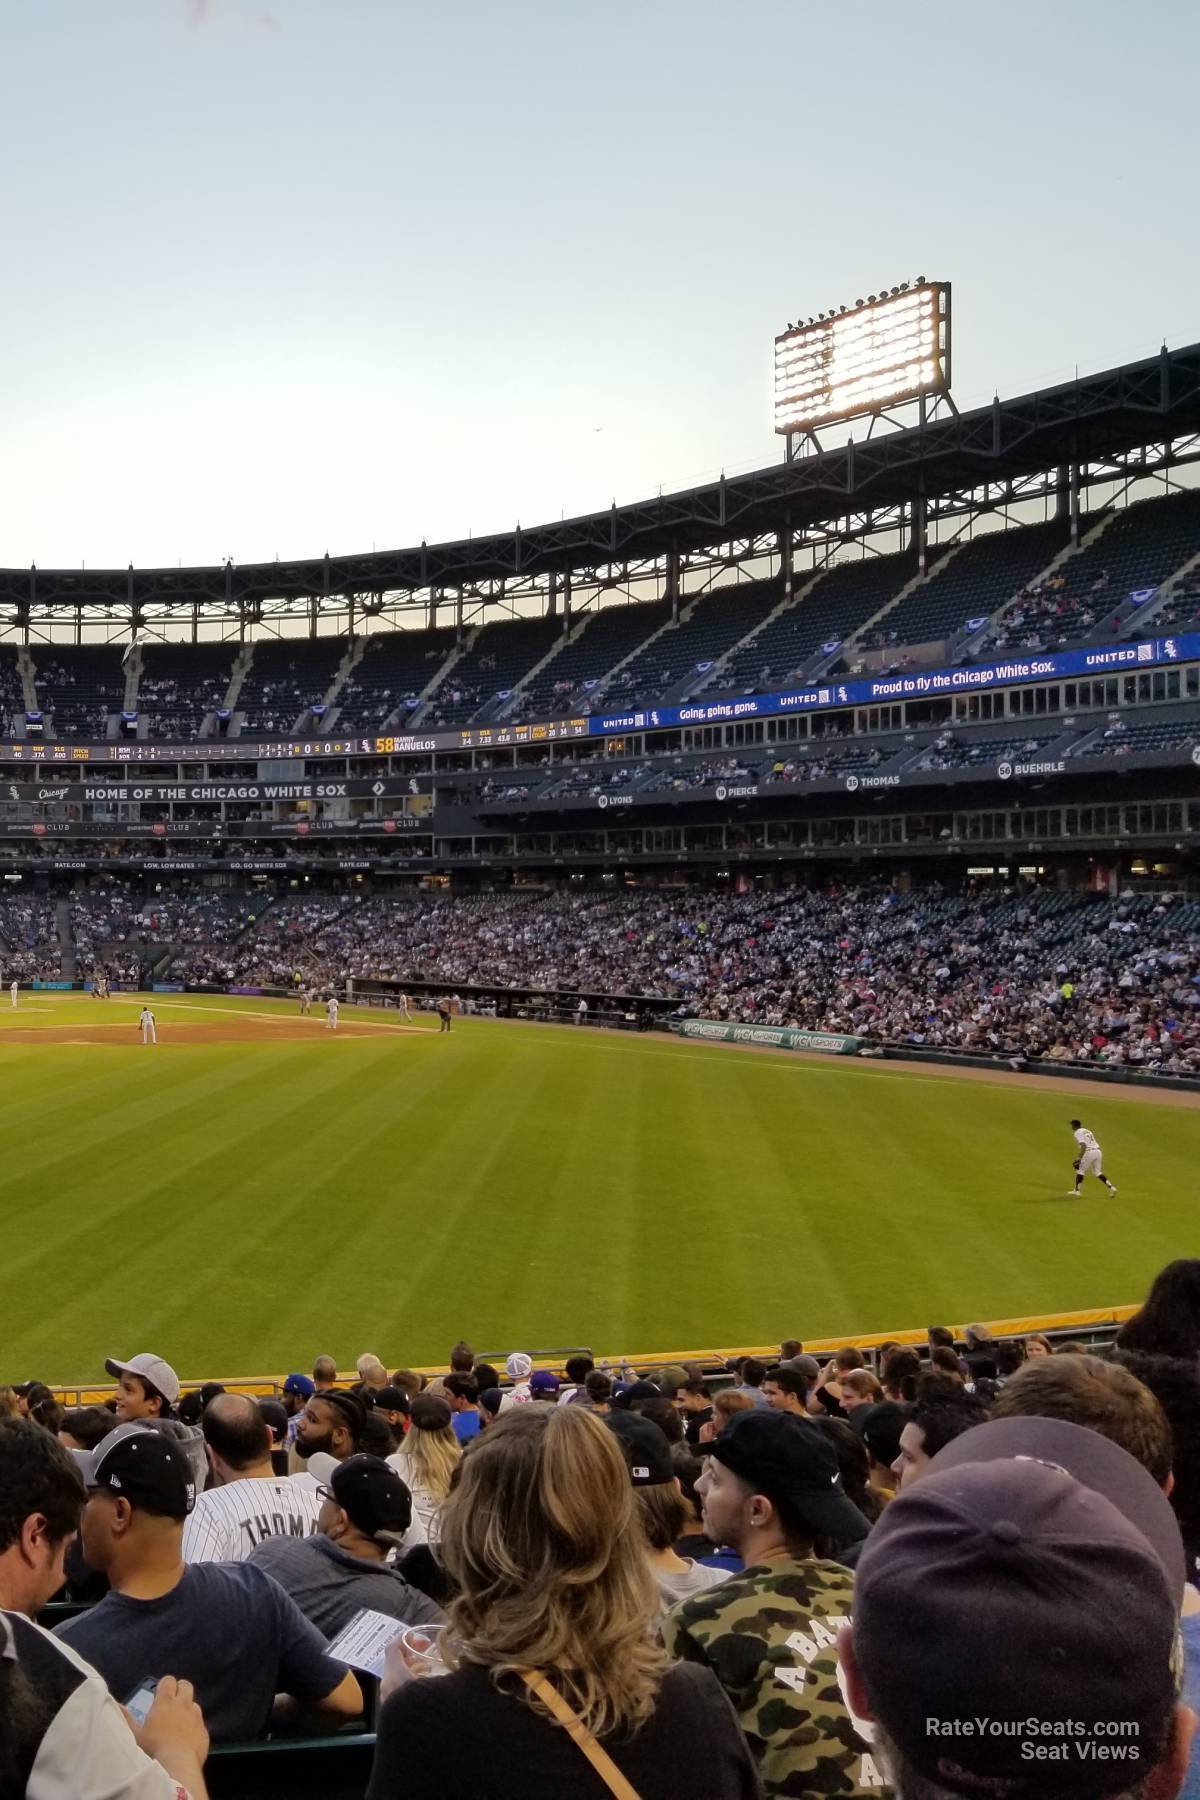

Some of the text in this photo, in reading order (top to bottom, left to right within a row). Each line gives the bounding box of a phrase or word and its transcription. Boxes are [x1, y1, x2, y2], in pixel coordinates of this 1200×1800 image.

[1086, 650, 1136, 665] UNITED
[873, 661, 1055, 695] Proud to fly the Chicago White Sox.
[780, 693, 817, 706] UNITED
[680, 702, 758, 720] Going, going, gone.
[570, 718, 586, 726] TOTAL
[603, 718, 634, 728] UNITED
[548, 726, 582, 737] 20 34 54
[376, 737, 394, 753] 58
[394, 735, 415, 744] MANNY
[304, 744, 311, 754] 0
[324, 743, 331, 753] 0
[344, 742, 351, 752] 2
[999, 761, 1065, 776] 56 BUEHRLE
[847, 775, 900, 788] 35 THOMAS
[85, 784, 347, 800] HOME OF THE CHICAGO WHITE SOX
[728, 785, 758, 797] PIERCE
[609, 795, 633, 805] LYONS
[47, 823, 70, 831] CLUB
[310, 822, 333, 830] CLUB
[684, 1022, 705, 1034] WGN
[733, 1028, 783, 1043] WGN SPORTS
[789, 1034, 845, 1050] WGN SPORTS
[774, 1665, 807, 1695] A
